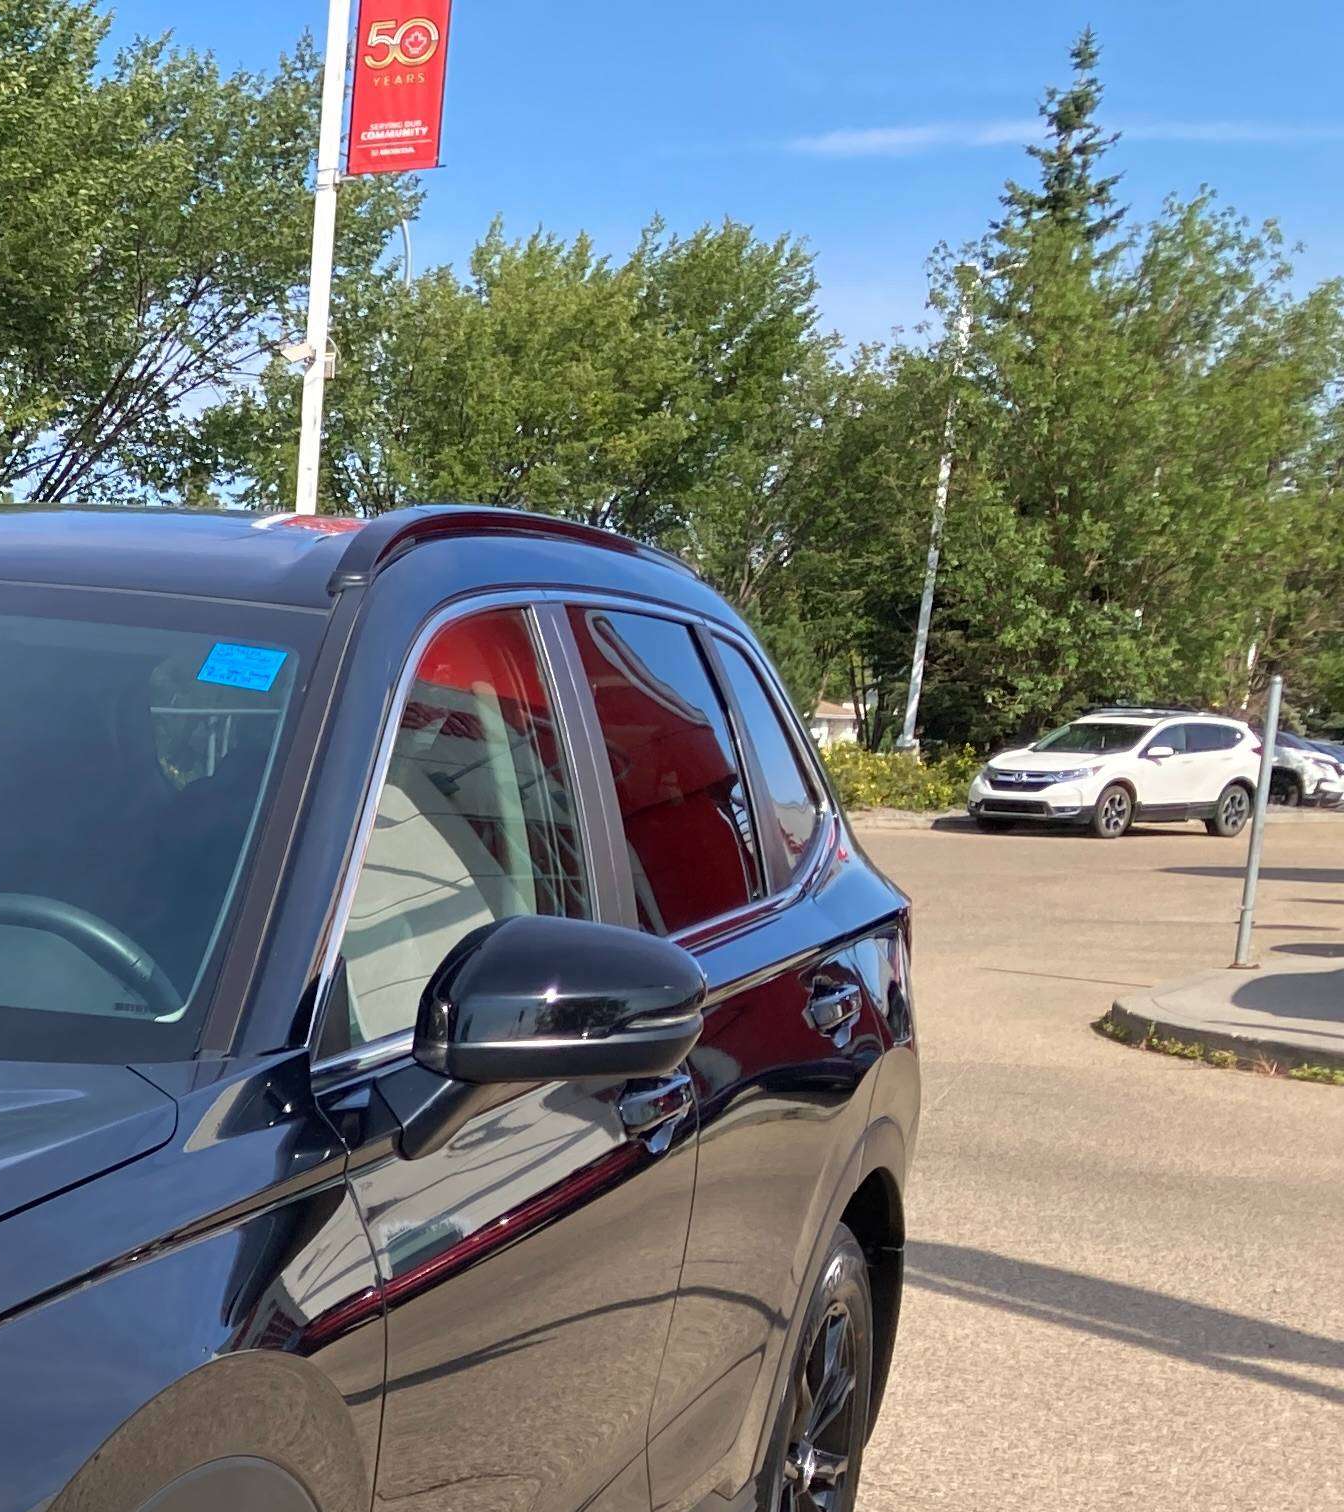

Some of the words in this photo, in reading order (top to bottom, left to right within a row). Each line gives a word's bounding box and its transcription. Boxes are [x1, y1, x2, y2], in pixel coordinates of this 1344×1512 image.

[363, 17, 440, 70] 50
[373, 72, 425, 87] YEARS
[370, 122, 403, 131] SERVING
[404, 119, 423, 128] OUR
[361, 126, 429, 141] COMMUNITY
